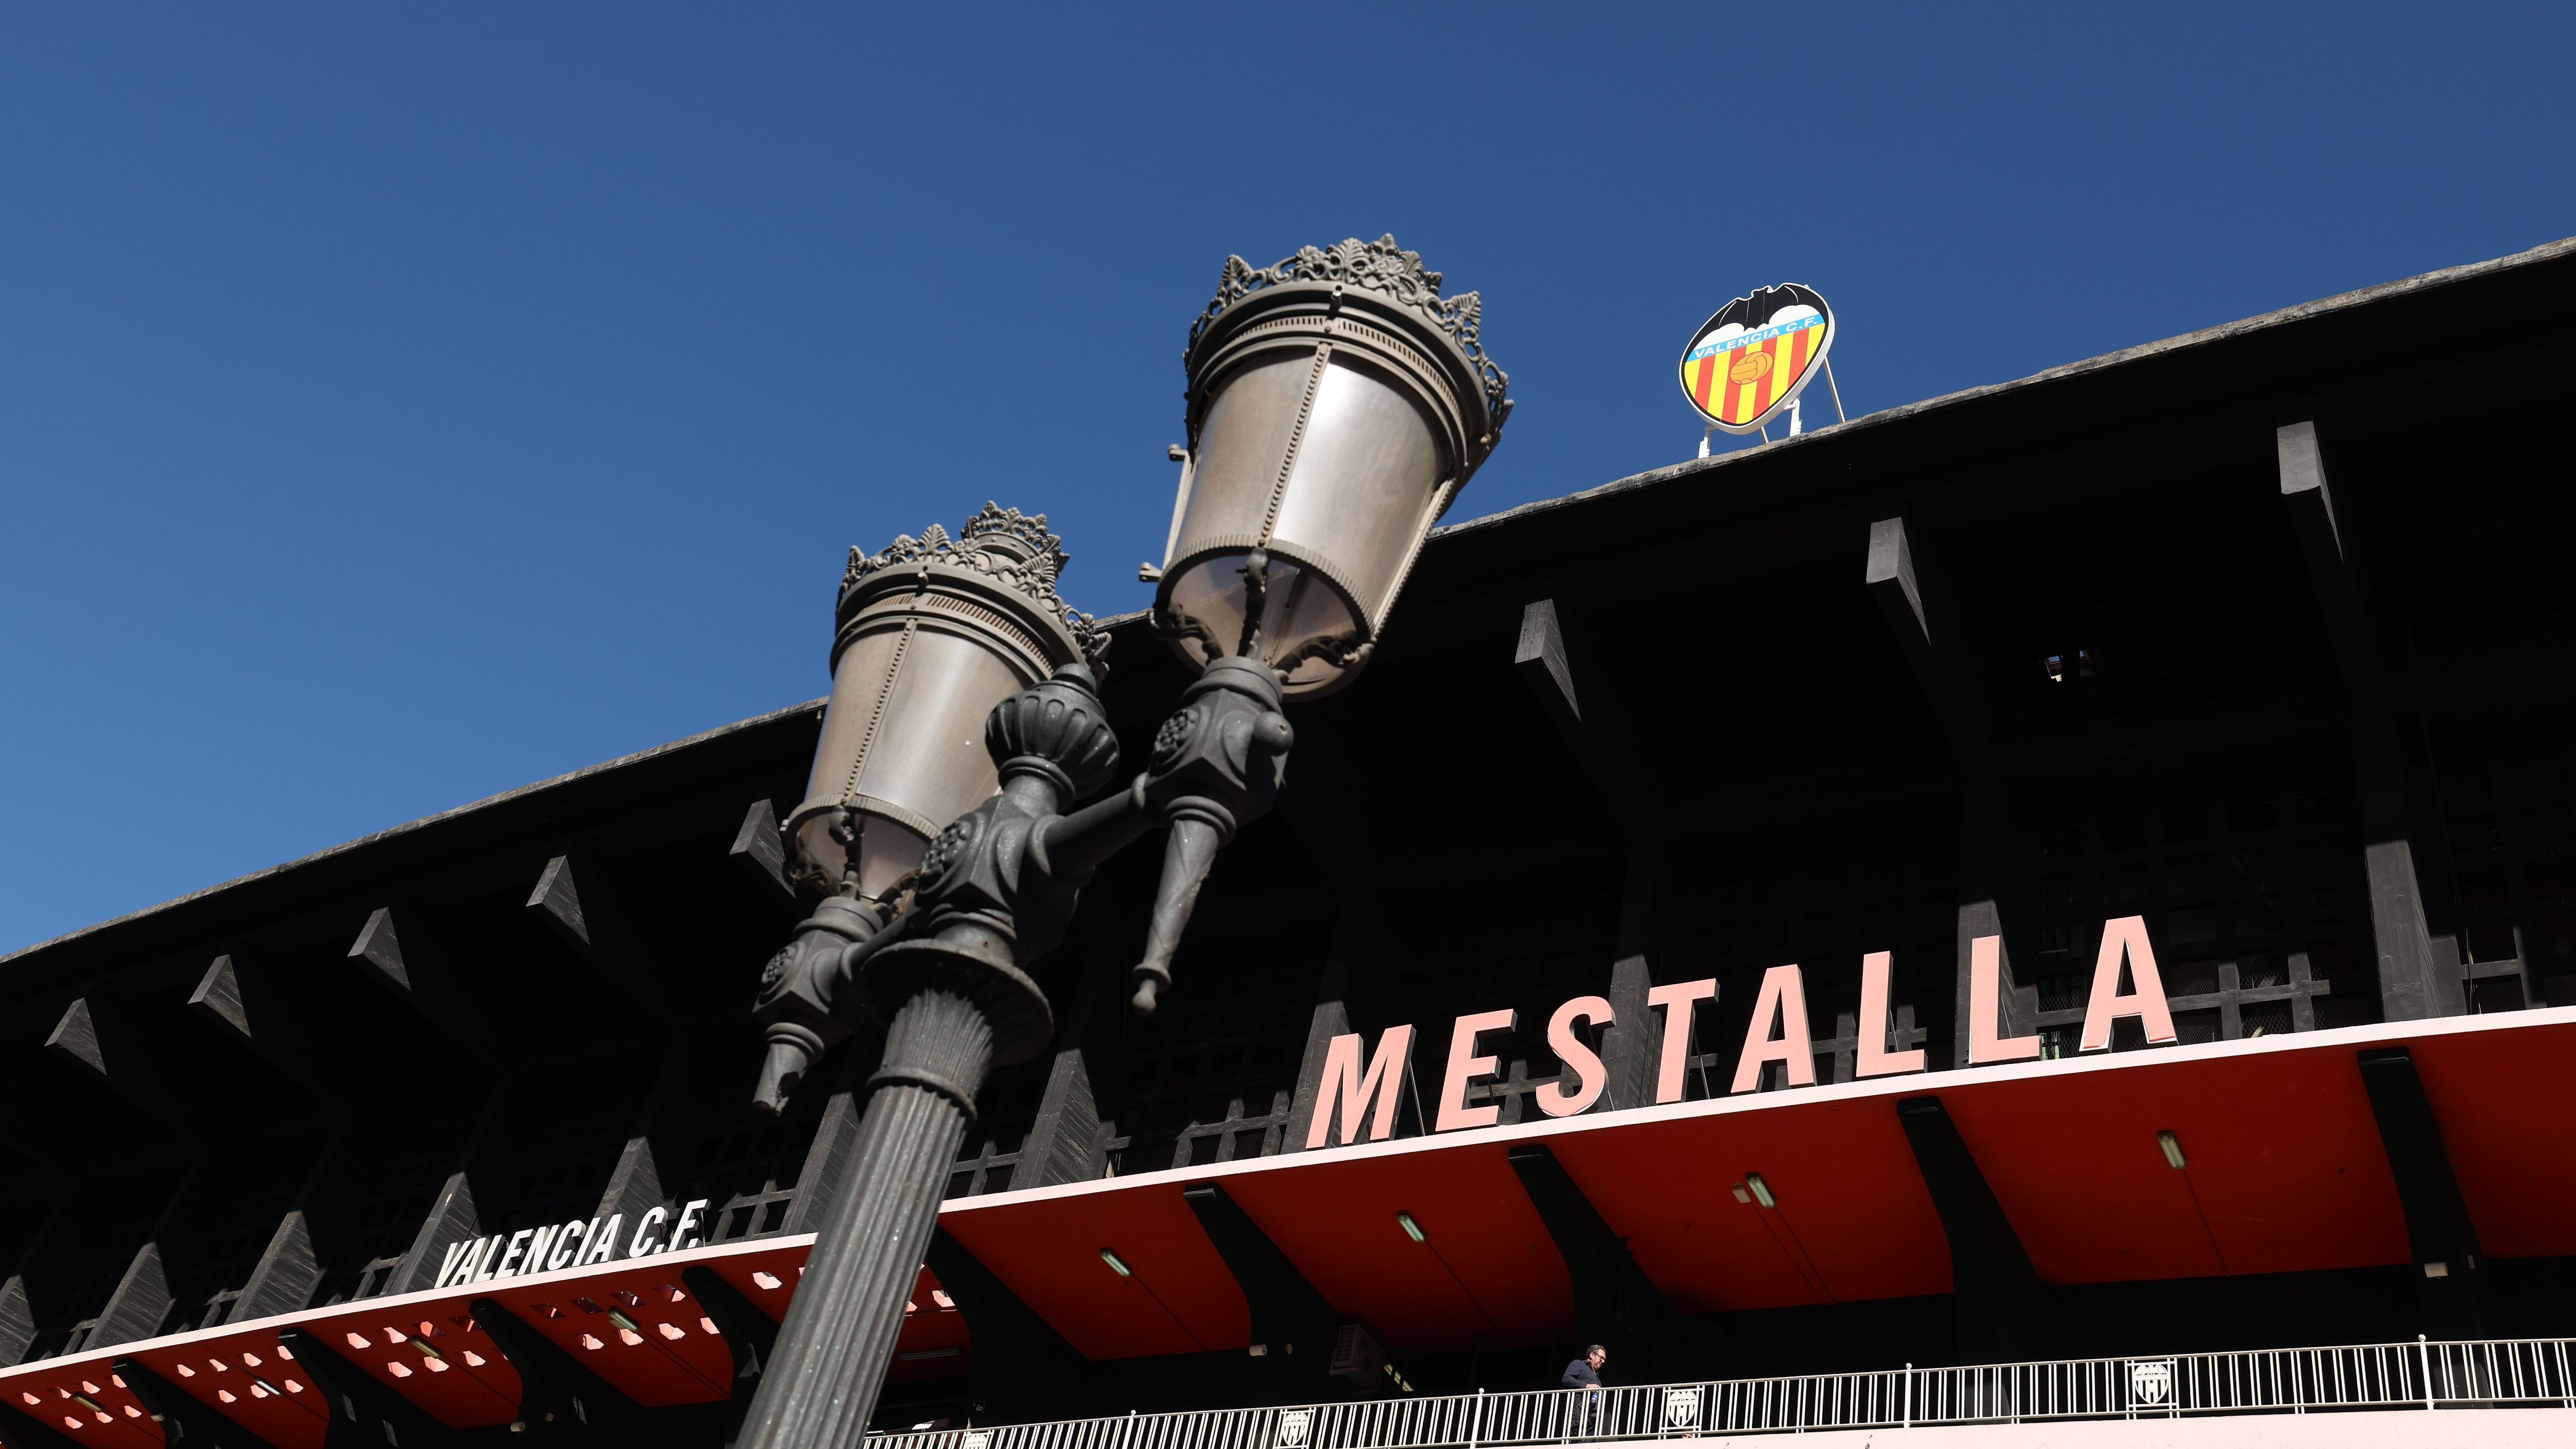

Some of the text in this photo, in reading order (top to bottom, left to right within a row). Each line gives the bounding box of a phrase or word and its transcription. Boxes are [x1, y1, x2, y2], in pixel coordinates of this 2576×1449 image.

[1695, 317, 1817, 359] VALENCIA C.F.
[1304, 915, 2178, 1149] MESTALLA
[434, 1199, 710, 1289] VALENCIA C.F.
